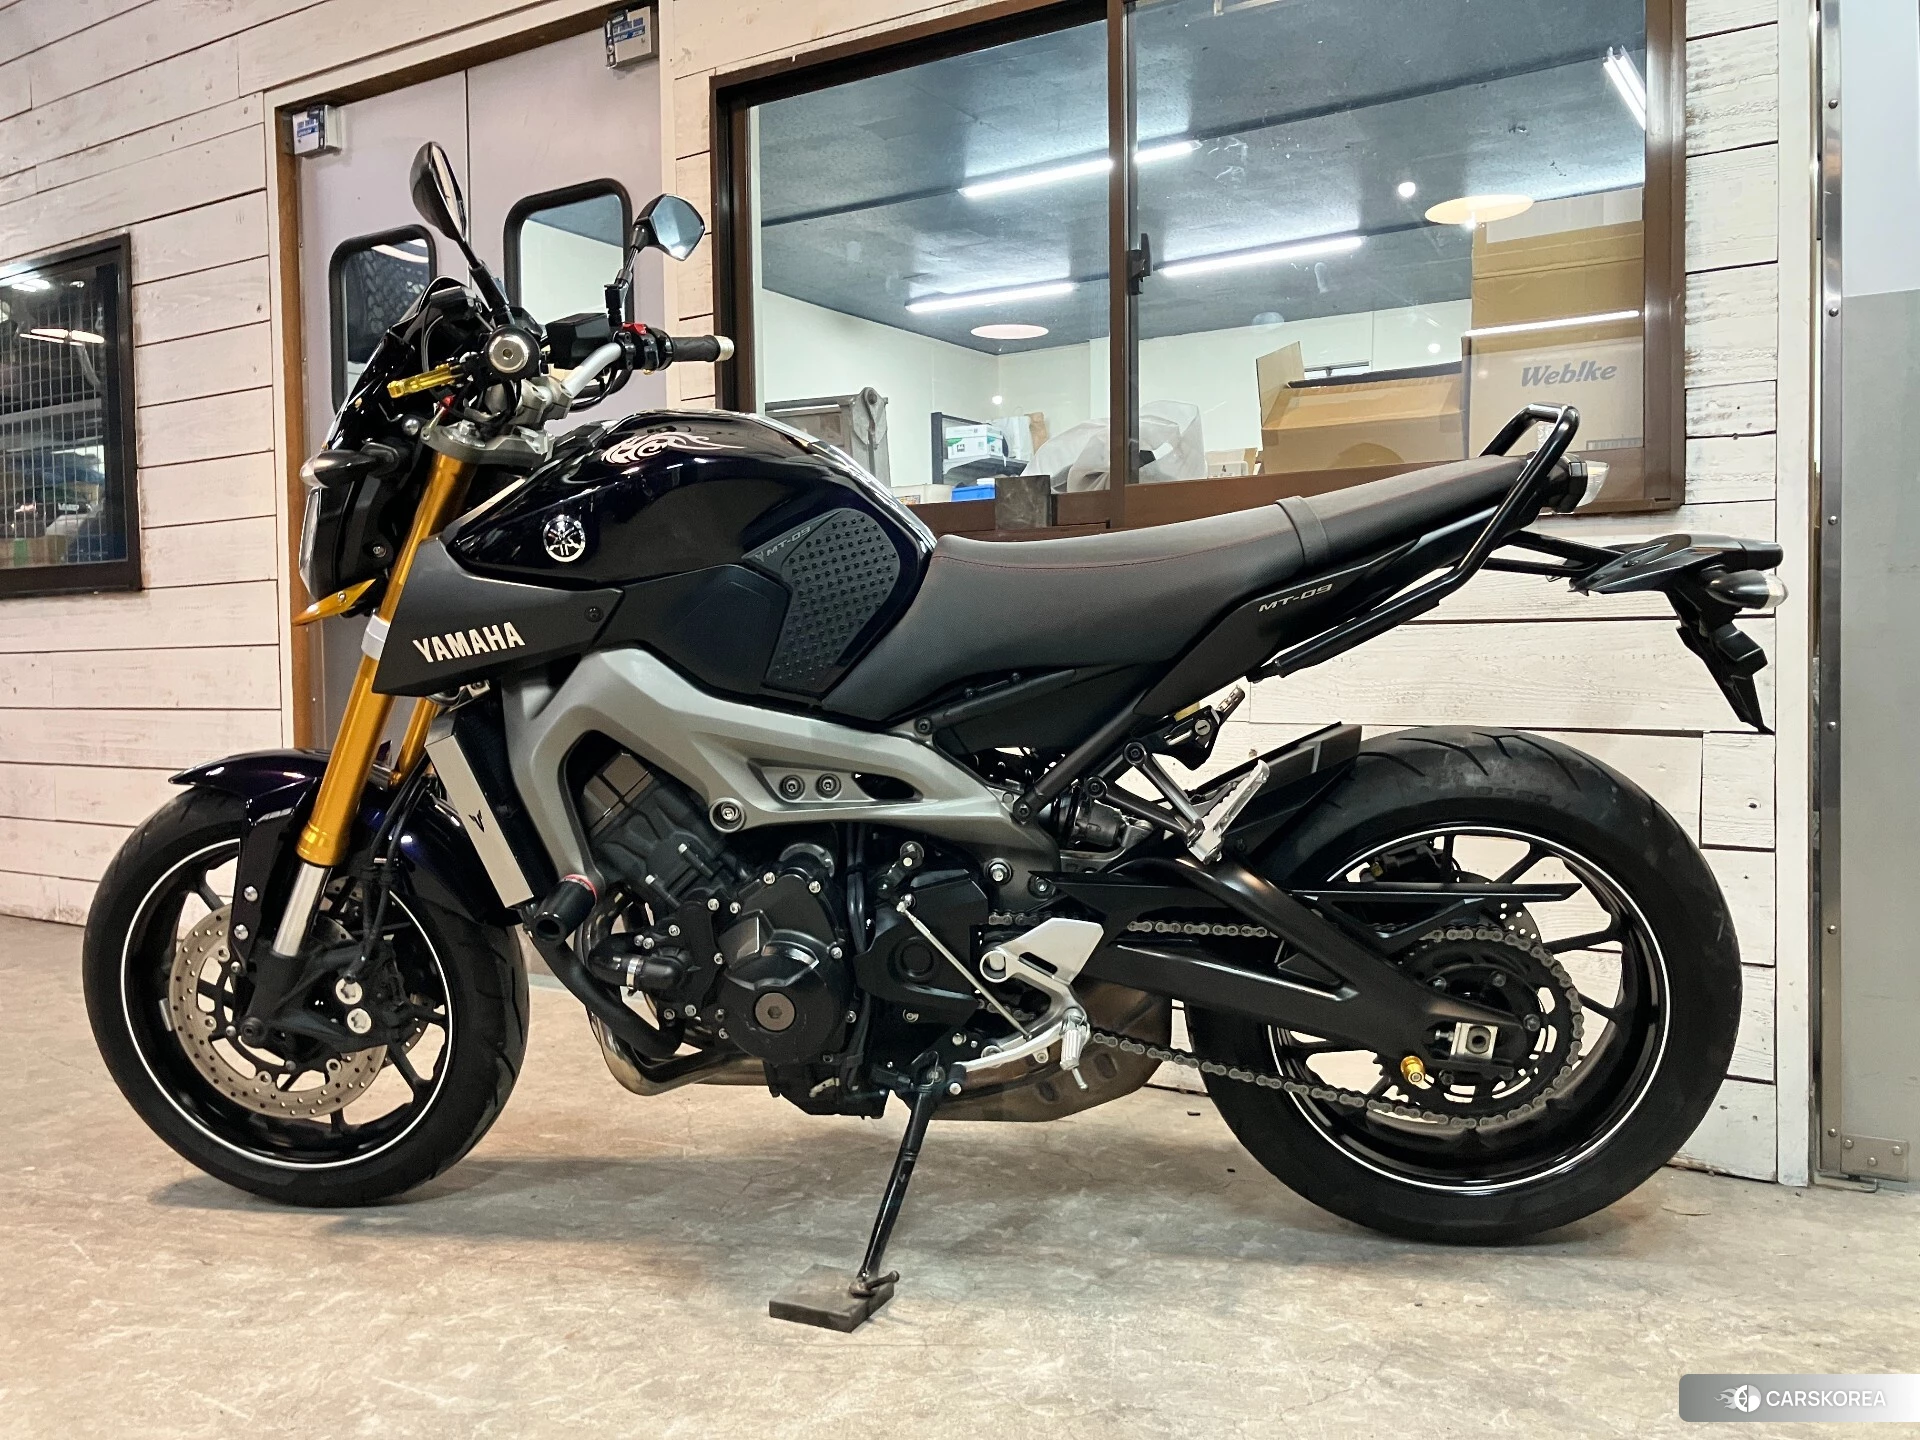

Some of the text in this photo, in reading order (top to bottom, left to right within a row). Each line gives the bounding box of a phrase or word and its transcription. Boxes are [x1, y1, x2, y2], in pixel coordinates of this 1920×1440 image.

[766, 526, 811, 556] MT-09
[1258, 583, 1333, 612] MT-09
[412, 621, 526, 663] YAMAHA
